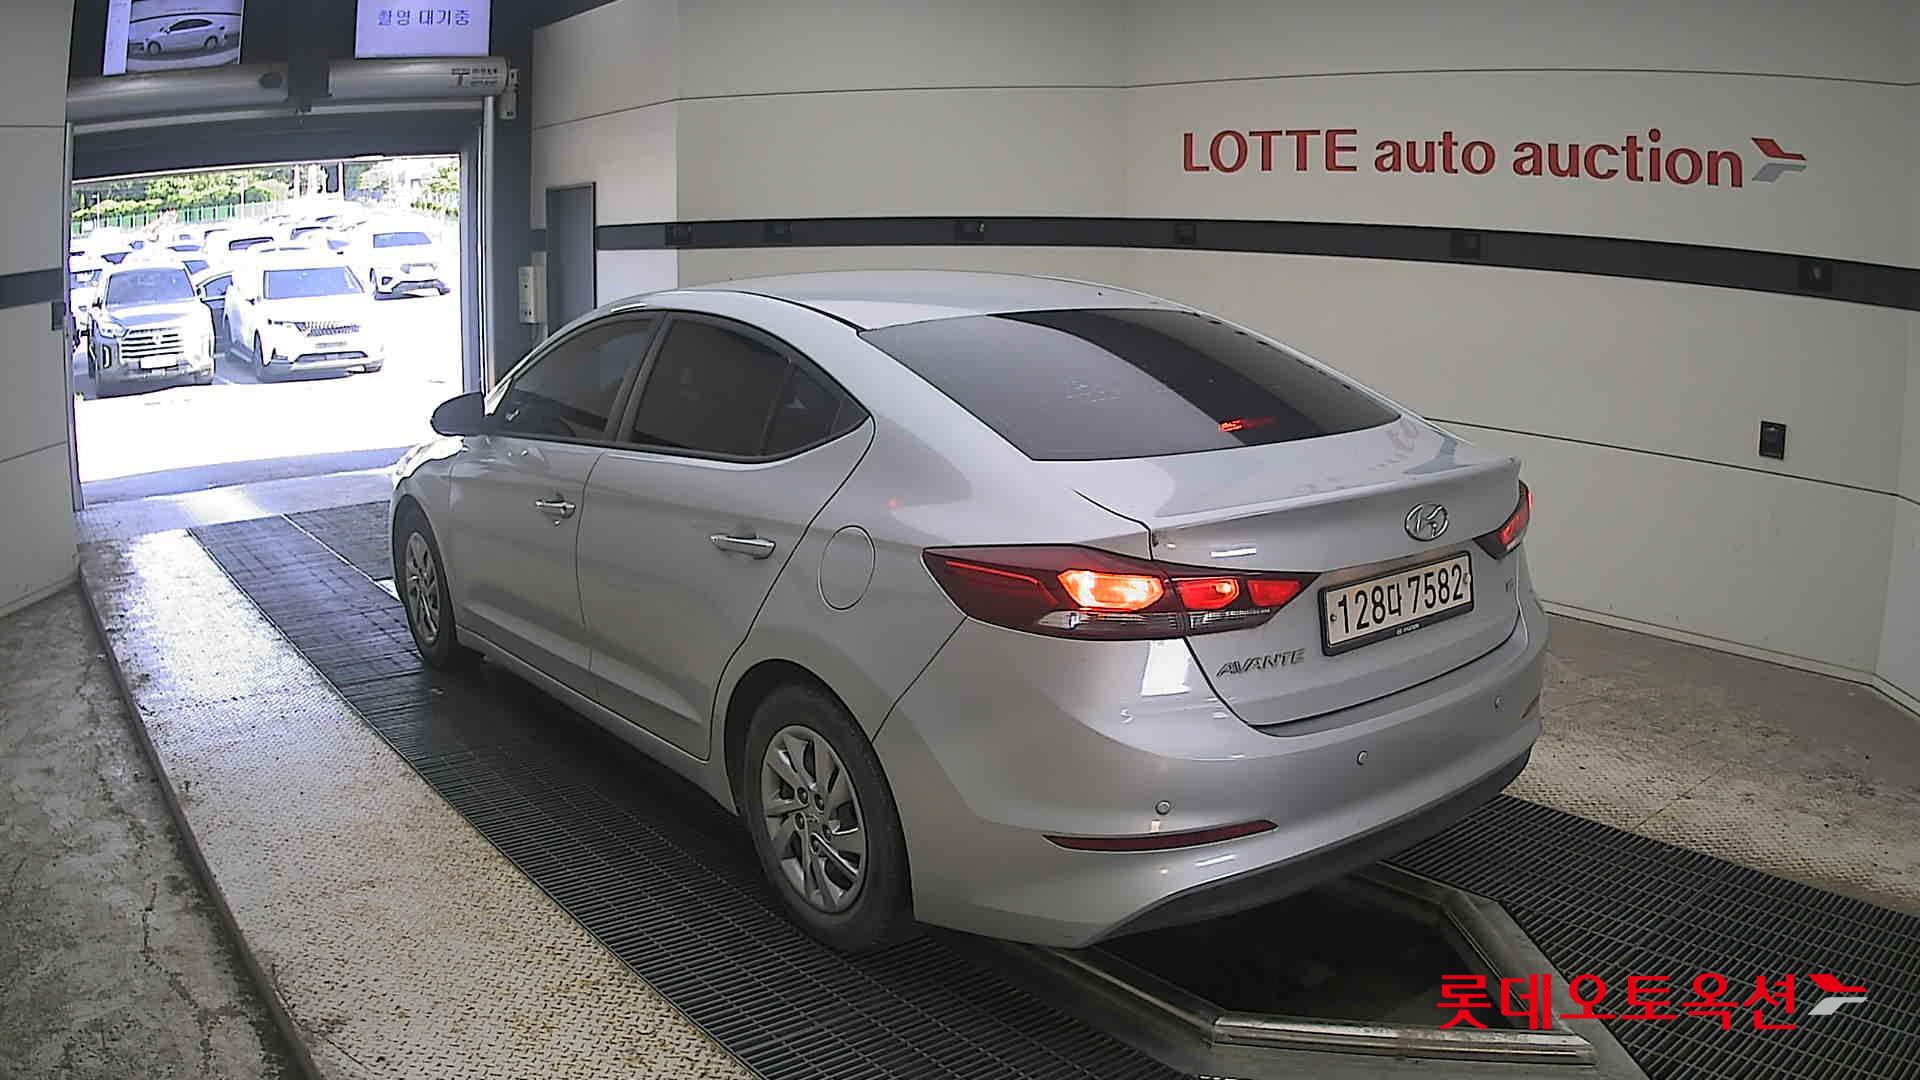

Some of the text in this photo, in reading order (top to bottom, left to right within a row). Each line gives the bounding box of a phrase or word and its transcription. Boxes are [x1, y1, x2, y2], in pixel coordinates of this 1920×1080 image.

[419, 9, 471, 26] 대기중
[1184, 129, 1743, 189] LOTTE auto auction
[1338, 564, 1464, 634] 128다 7582
[1216, 648, 1305, 677] AVANTE
